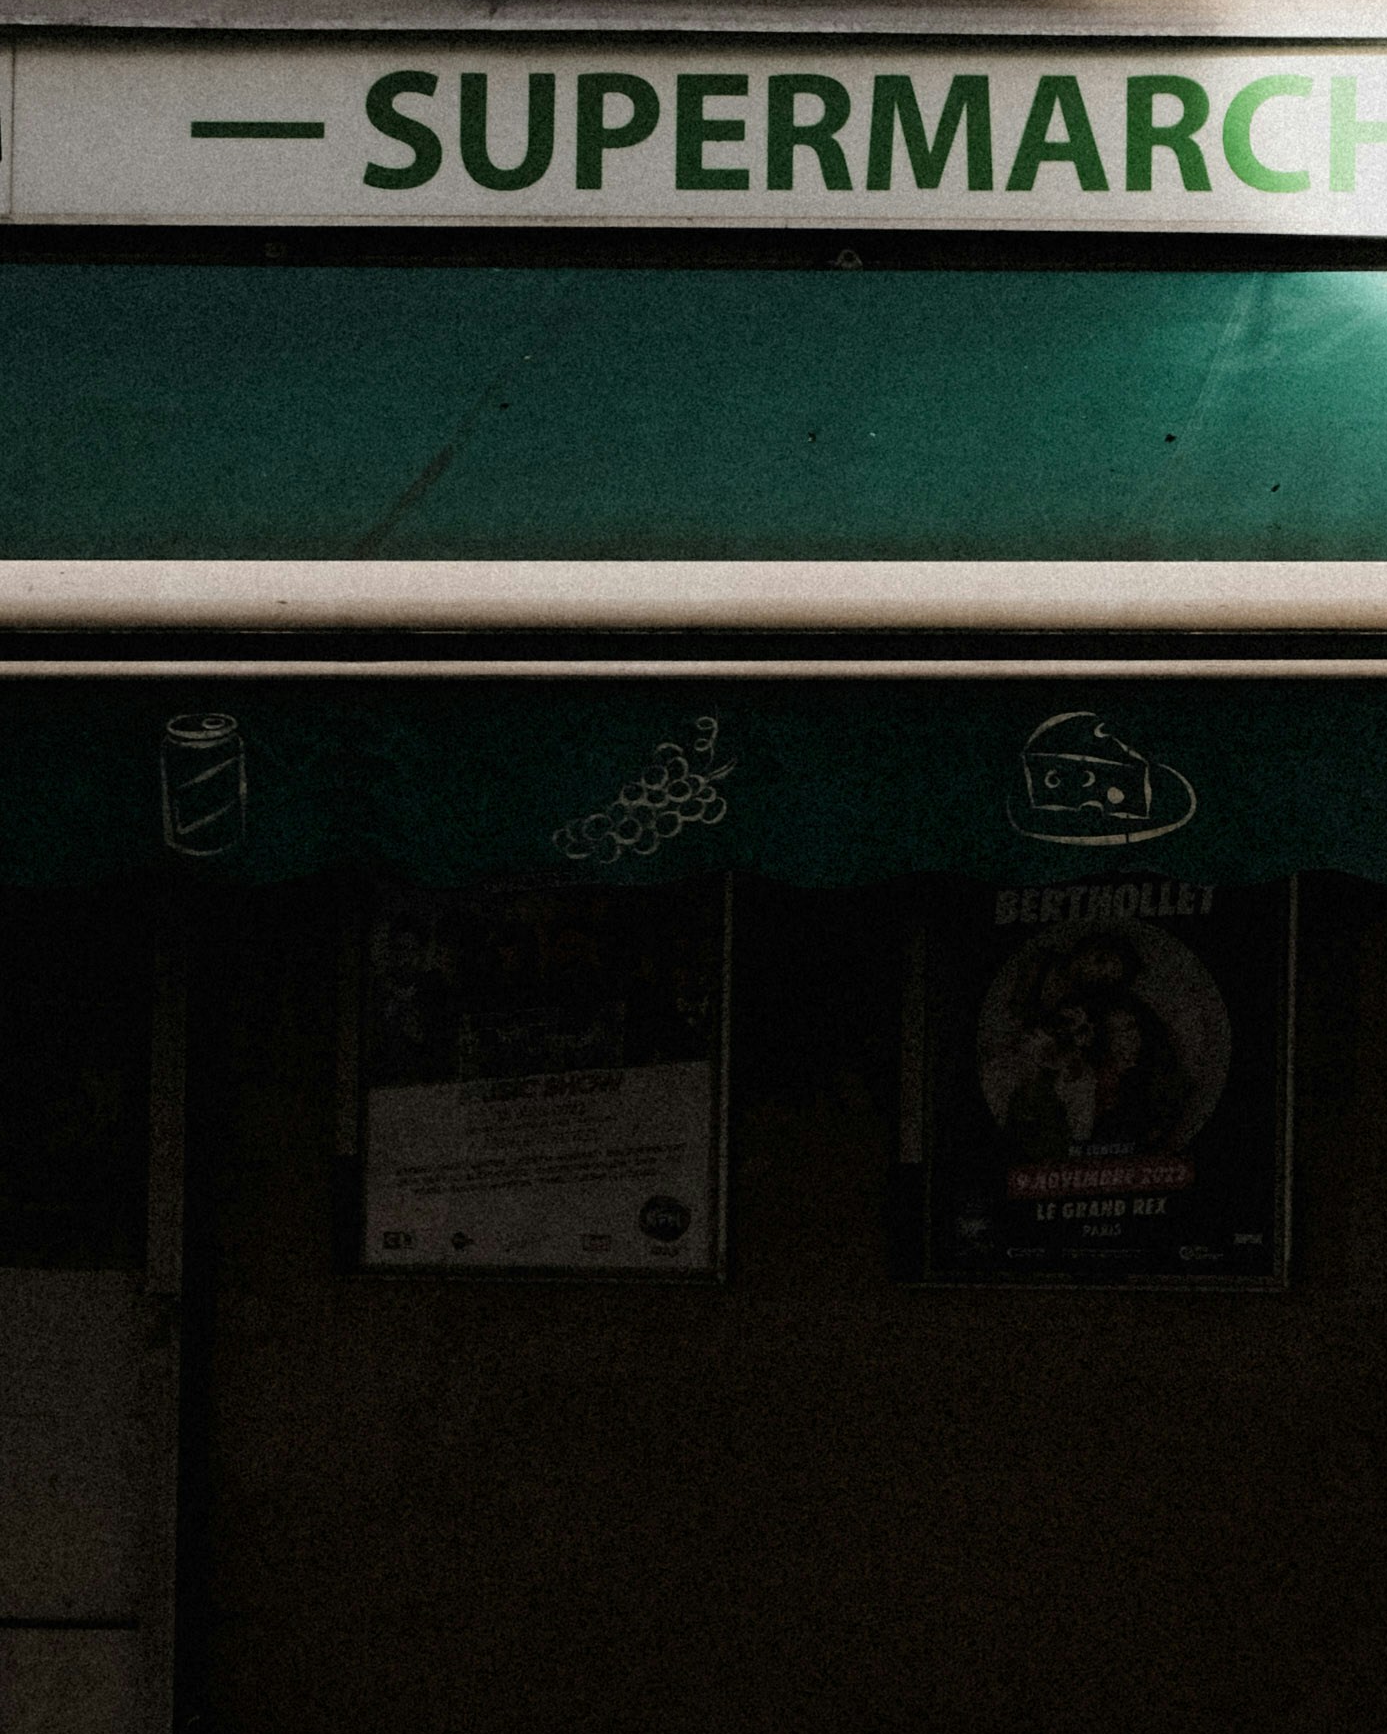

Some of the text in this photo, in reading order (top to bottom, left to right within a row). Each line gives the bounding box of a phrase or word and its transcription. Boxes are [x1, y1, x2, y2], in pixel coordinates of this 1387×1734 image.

[993, 880, 1217, 926] BERTHOLLET
[1036, 1196, 1169, 1221] LE GRAND REX
